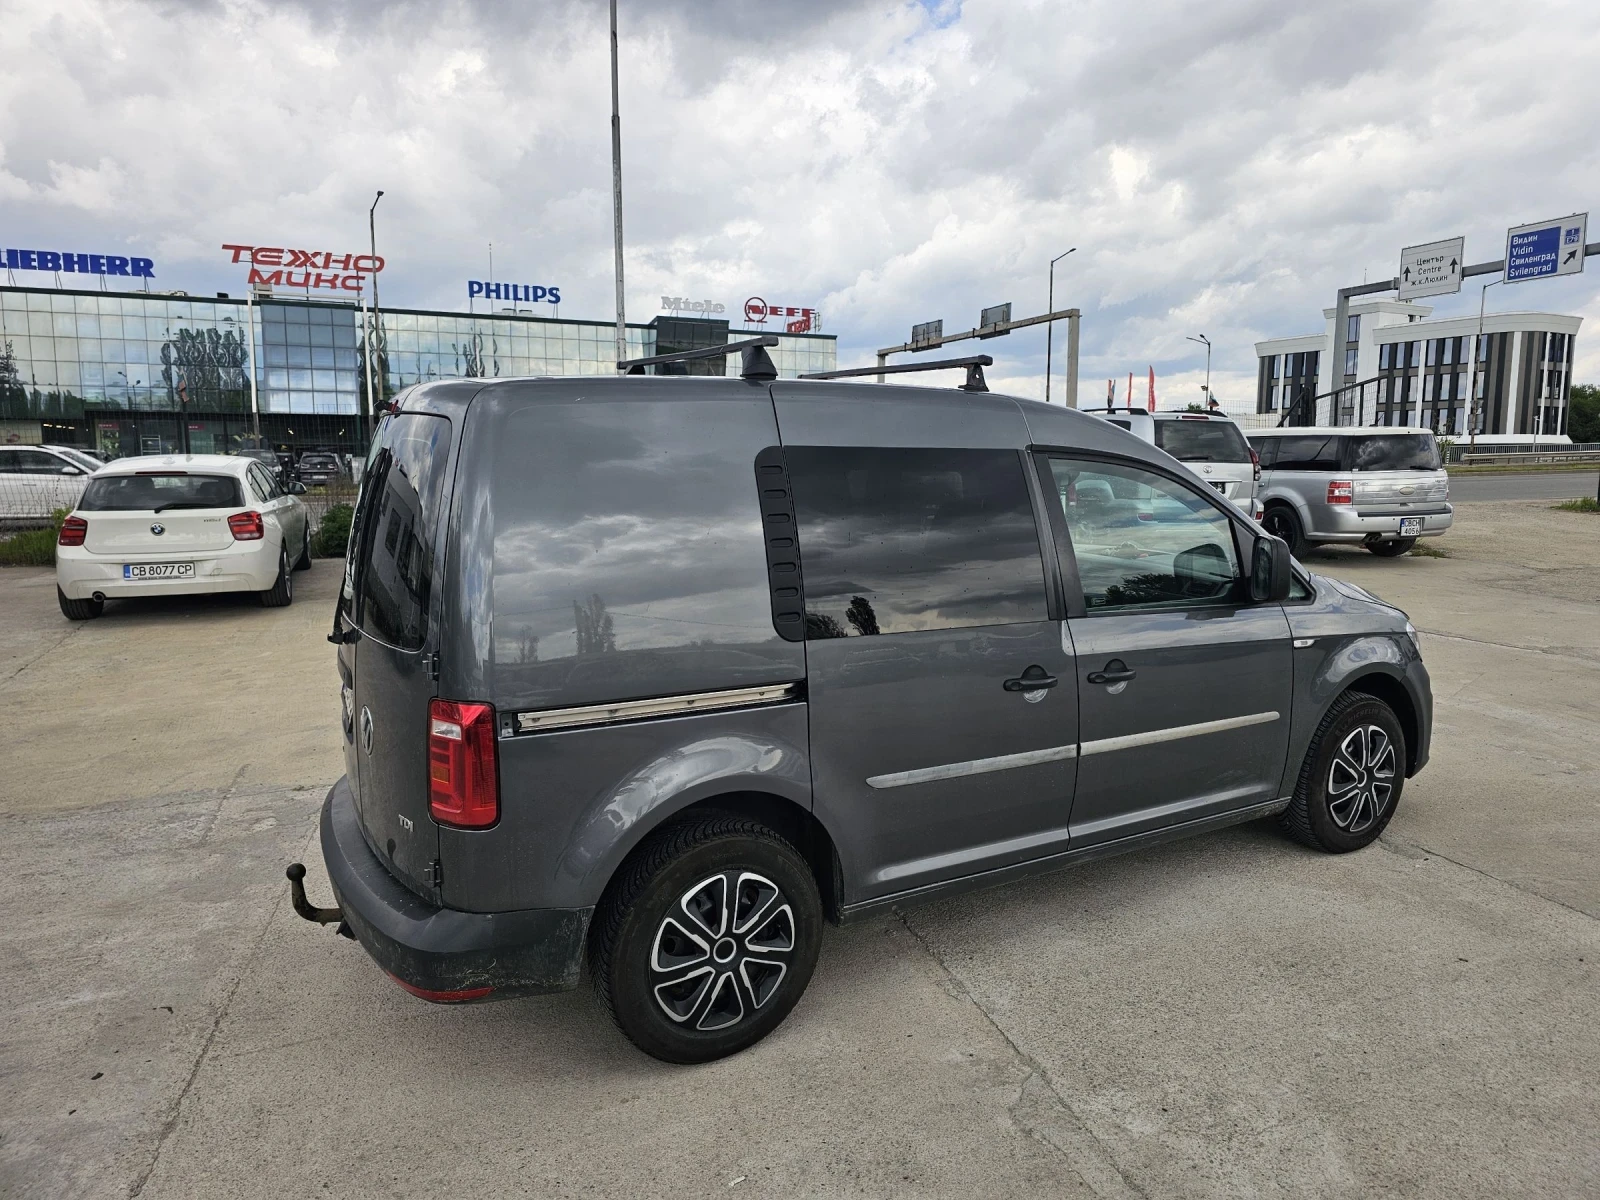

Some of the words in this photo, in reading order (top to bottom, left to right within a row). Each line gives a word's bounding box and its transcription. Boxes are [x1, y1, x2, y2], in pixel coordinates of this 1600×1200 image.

[1512, 235, 1538, 245] Видин
[1512, 246, 1534, 256] Vidin
[1416, 255, 1444, 266] Център
[1510, 252, 1556, 266] Свиленград
[1417, 266, 1442, 276] Centre
[1509, 262, 1552, 277] Svilengrad
[468, 280, 561, 304] PHILIPS
[661, 296, 726, 314] Miele
[1404, 527, 1420, 535] 4056
[131, 566, 147, 577] CB
[148, 565, 175, 576] 8077
[398, 813, 414, 833] TDI
